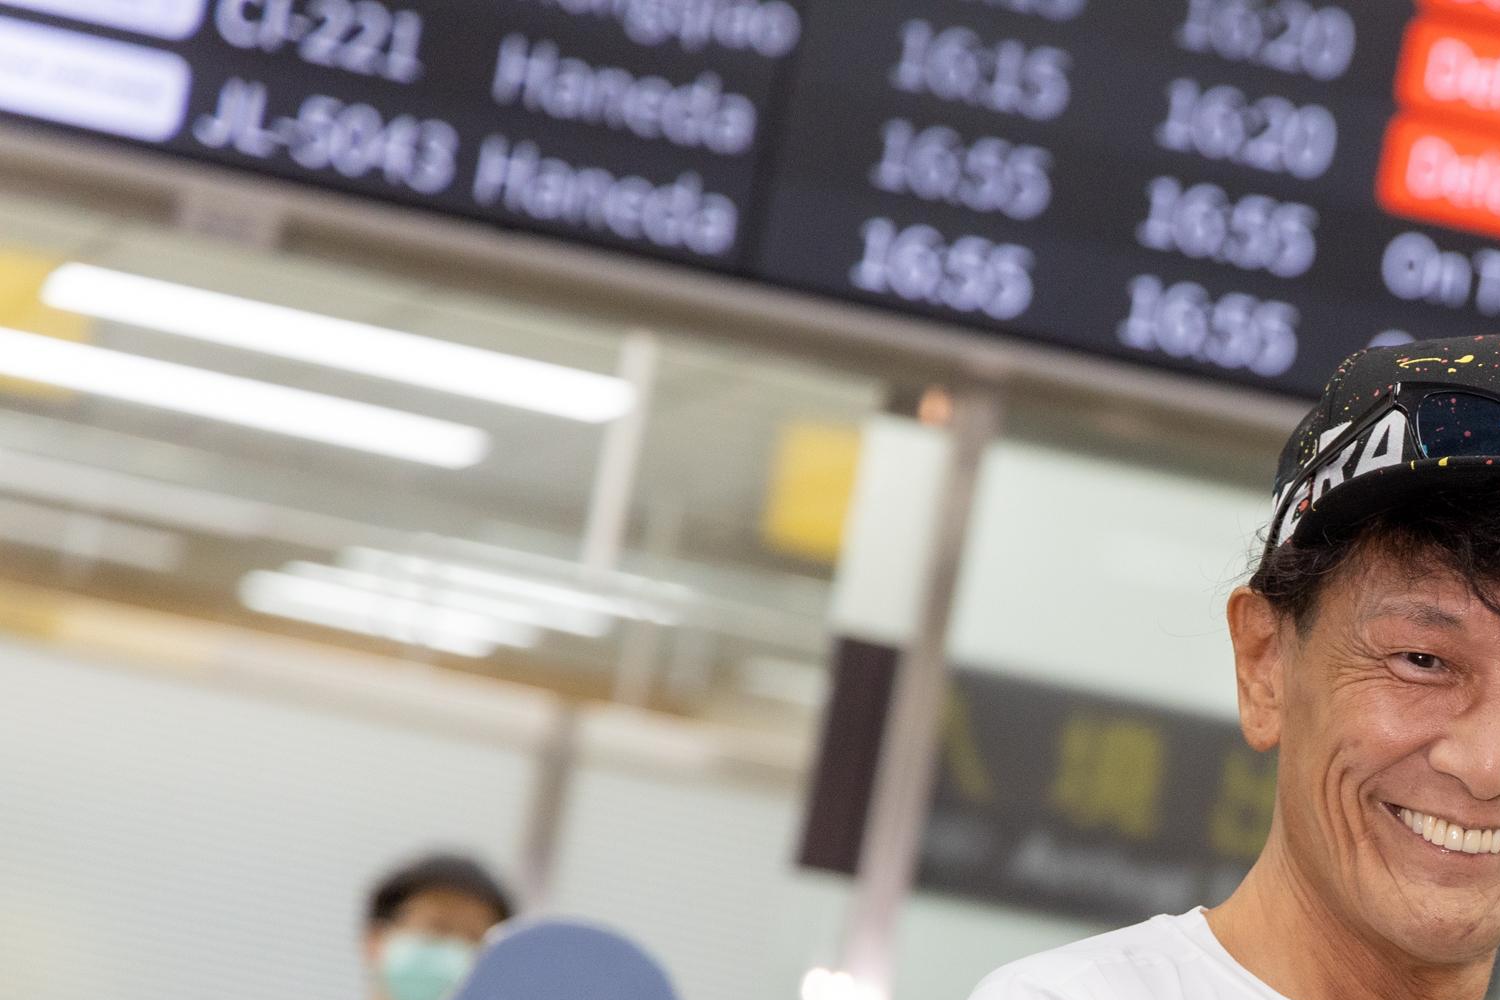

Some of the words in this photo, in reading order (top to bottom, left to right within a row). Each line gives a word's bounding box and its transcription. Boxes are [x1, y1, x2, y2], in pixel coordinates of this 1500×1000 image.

[194, 77, 459, 193] JL-5043
[473, 135, 738, 254] Haneda
[850, 217, 1034, 319] 16:55
[1118, 275, 1300, 376] 16:55
[492, 32, 757, 154] Haneda
[870, 118, 1052, 219] 16:55
[1136, 176, 1318, 277] 16:55
[1381, 232, 1472, 308] On
[892, 20, 1070, 120] 16:15
[1156, 79, 1337, 179] 16:20
